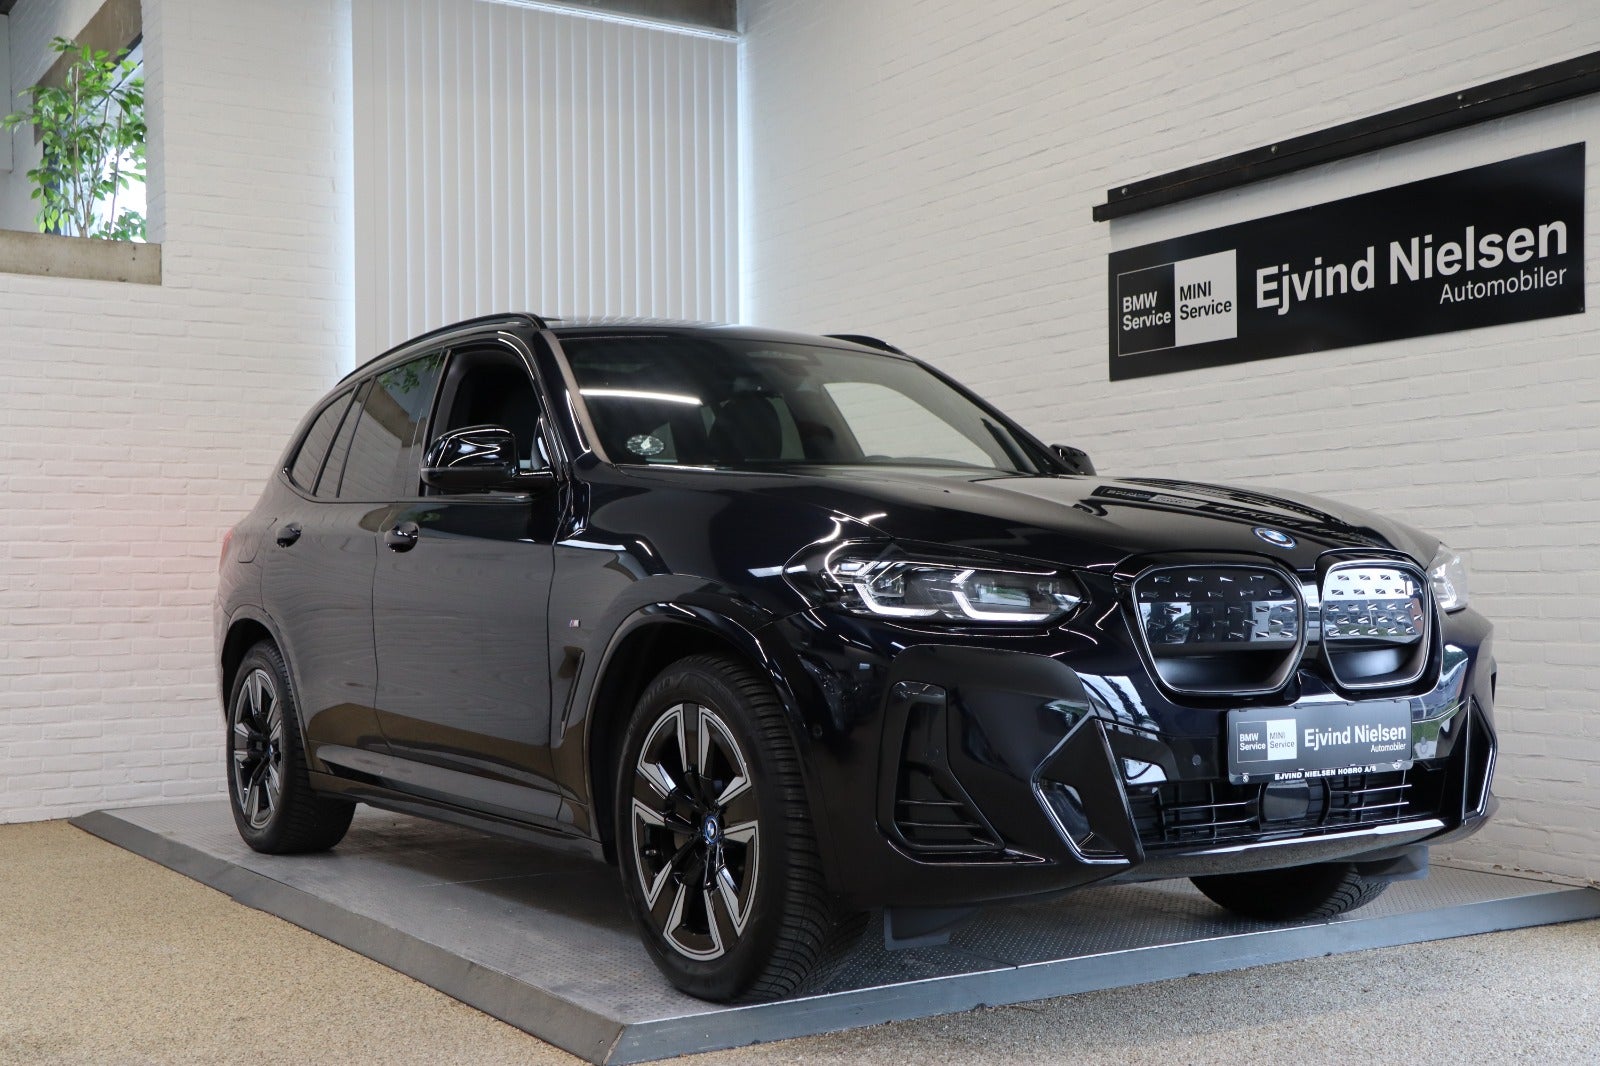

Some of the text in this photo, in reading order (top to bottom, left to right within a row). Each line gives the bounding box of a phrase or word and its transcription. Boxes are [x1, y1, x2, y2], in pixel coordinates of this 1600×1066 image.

[1256, 220, 1567, 316] Ejvind Nielsen
[1179, 280, 1212, 302] MINI
[1439, 265, 1567, 305] Automobiler
[1122, 291, 1158, 313] BMW
[1179, 297, 1232, 321] Service
[1122, 308, 1172, 331] Service
[1239, 732, 1259, 742] BMW
[1239, 742, 1266, 751] Service
[1269, 731, 1286, 740] MINI
[1269, 740, 1295, 749] Service
[1304, 724, 1407, 751] Ejvind Nielsen
[1370, 743, 1407, 753] Automobiler
[1274, 765, 1377, 781] EJVIND NIELSEN HOBRO A/S
